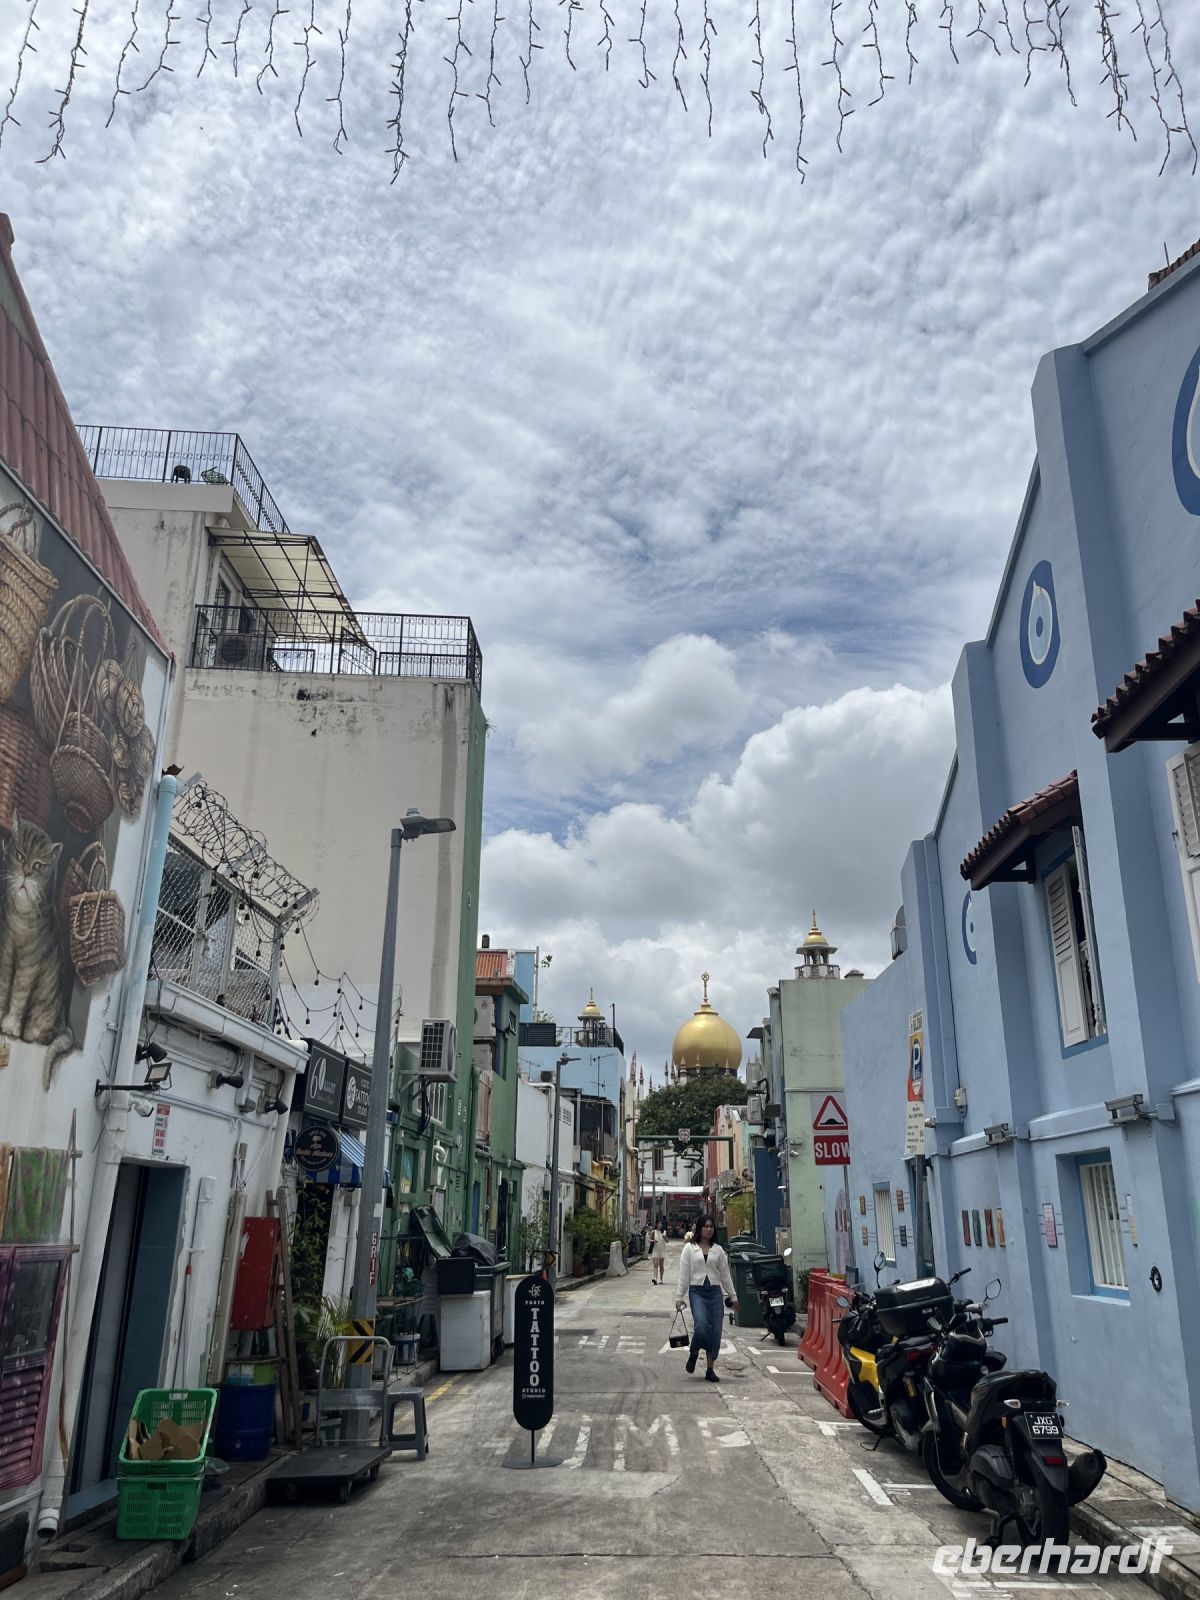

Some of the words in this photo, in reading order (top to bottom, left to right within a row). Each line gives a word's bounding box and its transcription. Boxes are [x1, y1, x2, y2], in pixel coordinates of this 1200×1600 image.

[355, 1088, 371, 1106] TATTO
[815, 1142, 850, 1158] SLOW
[529, 1307, 540, 1387] TATTOO
[1034, 1416, 1053, 1425] JXG
[1032, 1425, 1059, 1435] 6799
